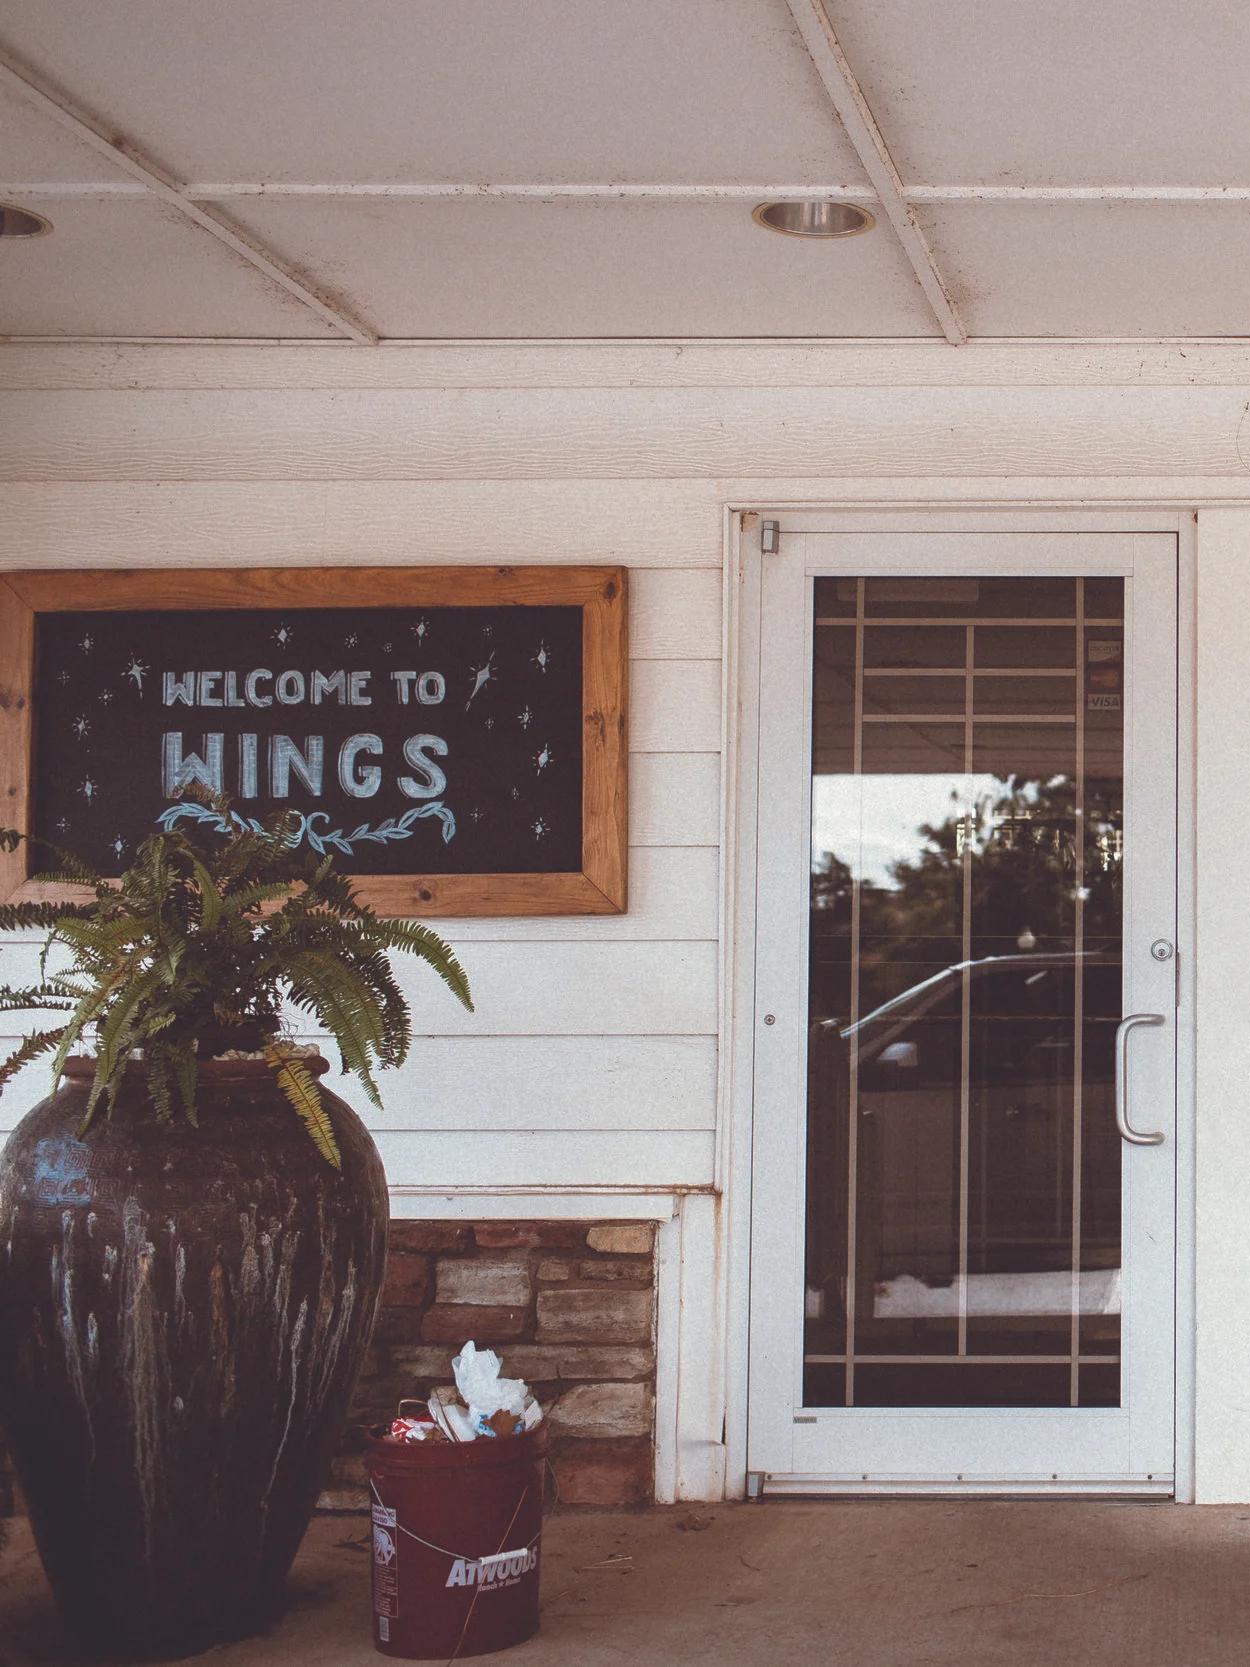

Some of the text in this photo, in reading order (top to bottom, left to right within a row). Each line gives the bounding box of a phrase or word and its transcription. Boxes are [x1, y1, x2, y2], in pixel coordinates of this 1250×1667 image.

[162, 669, 446, 707] WELCOME TO
[1092, 697, 1120, 707] VISA
[162, 732, 449, 798] WINGS
